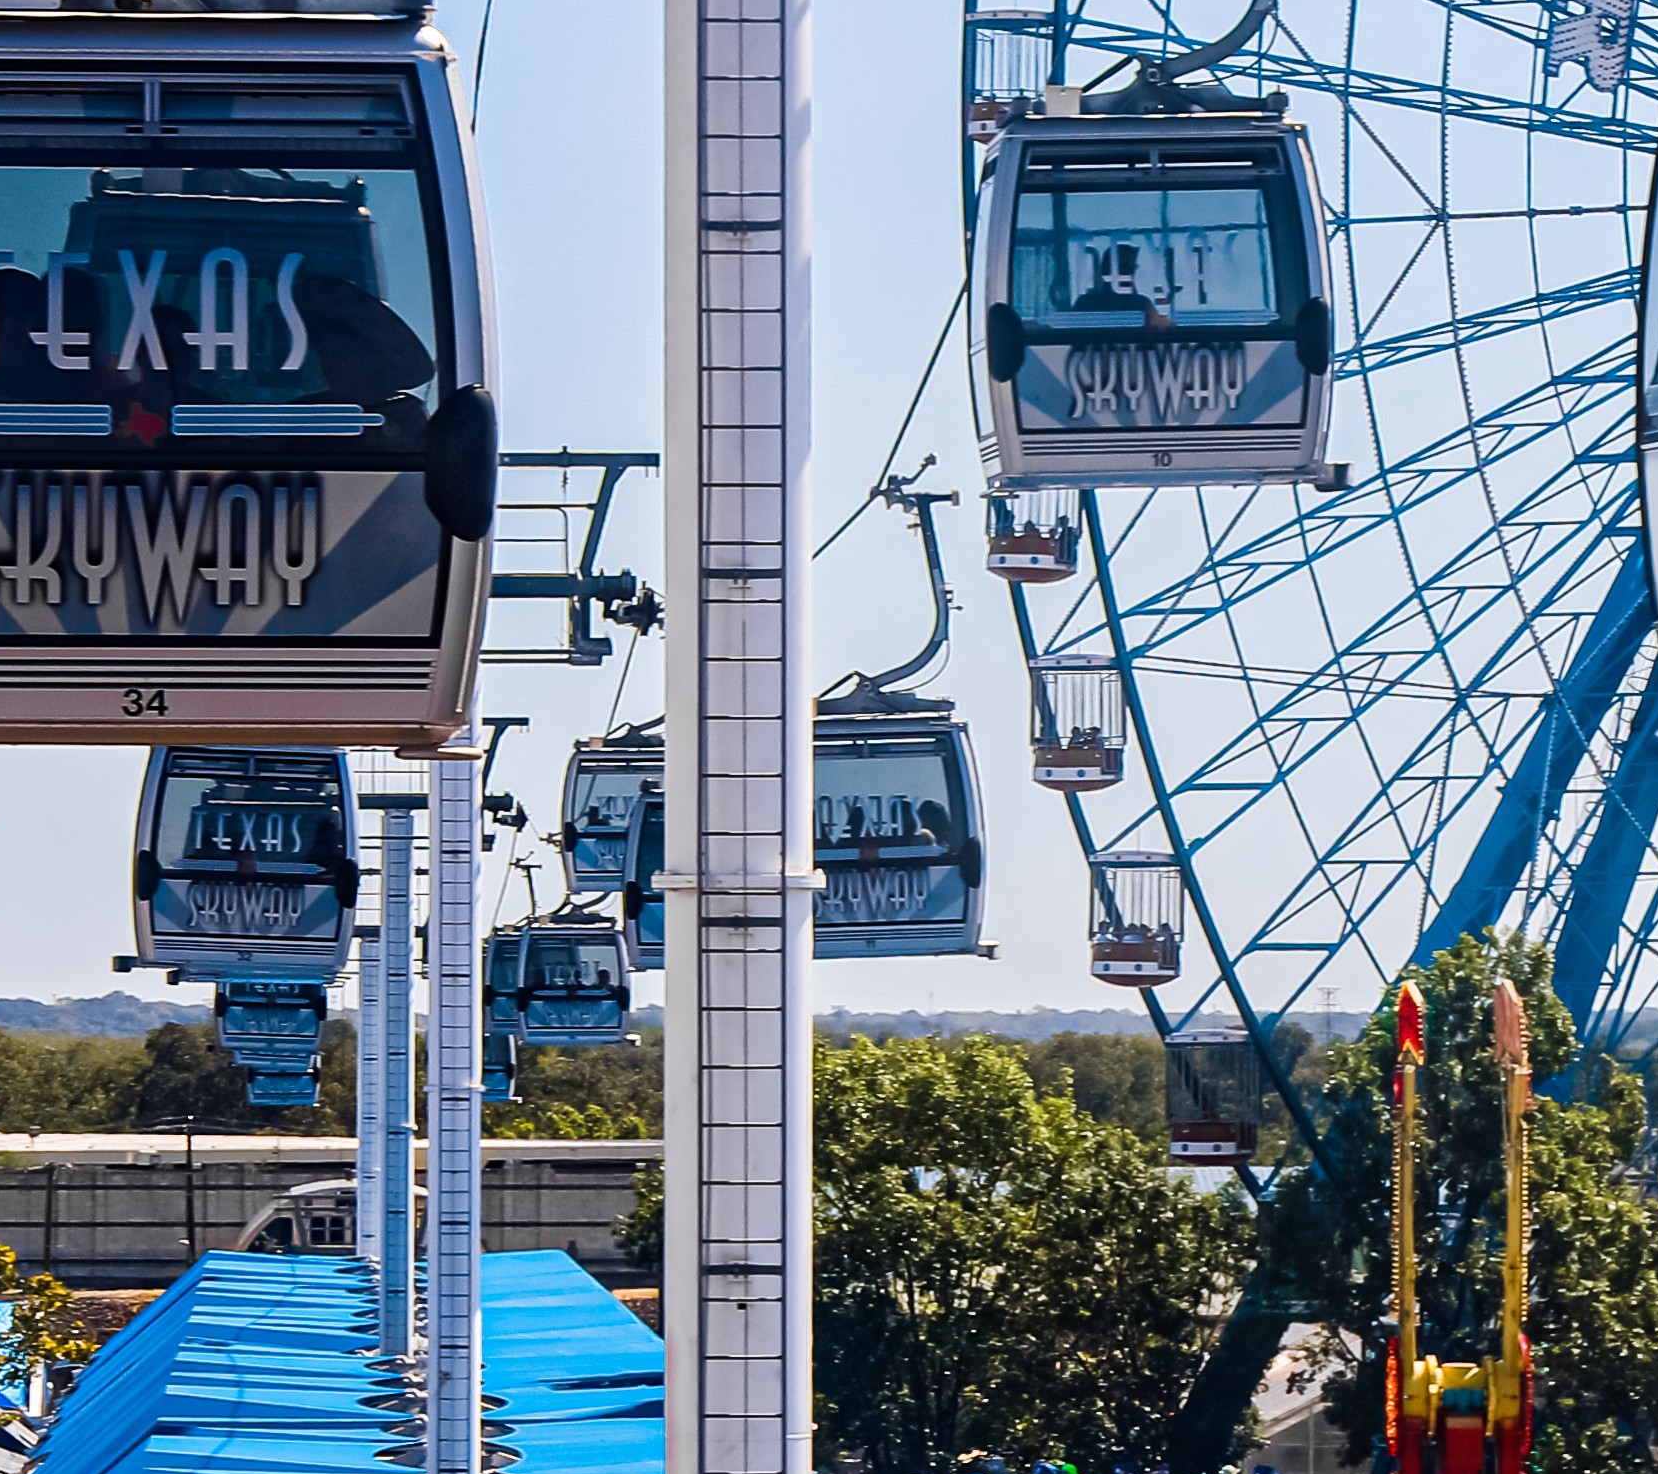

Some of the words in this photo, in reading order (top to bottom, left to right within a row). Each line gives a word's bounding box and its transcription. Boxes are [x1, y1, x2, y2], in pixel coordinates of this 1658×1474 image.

[1070, 345, 1246, 420] SKYWAY
[1151, 453, 1172, 468] 10
[121, 690, 169, 718] 34
[194, 811, 302, 854] TEXAS
[188, 886, 305, 930] SKYWAY
